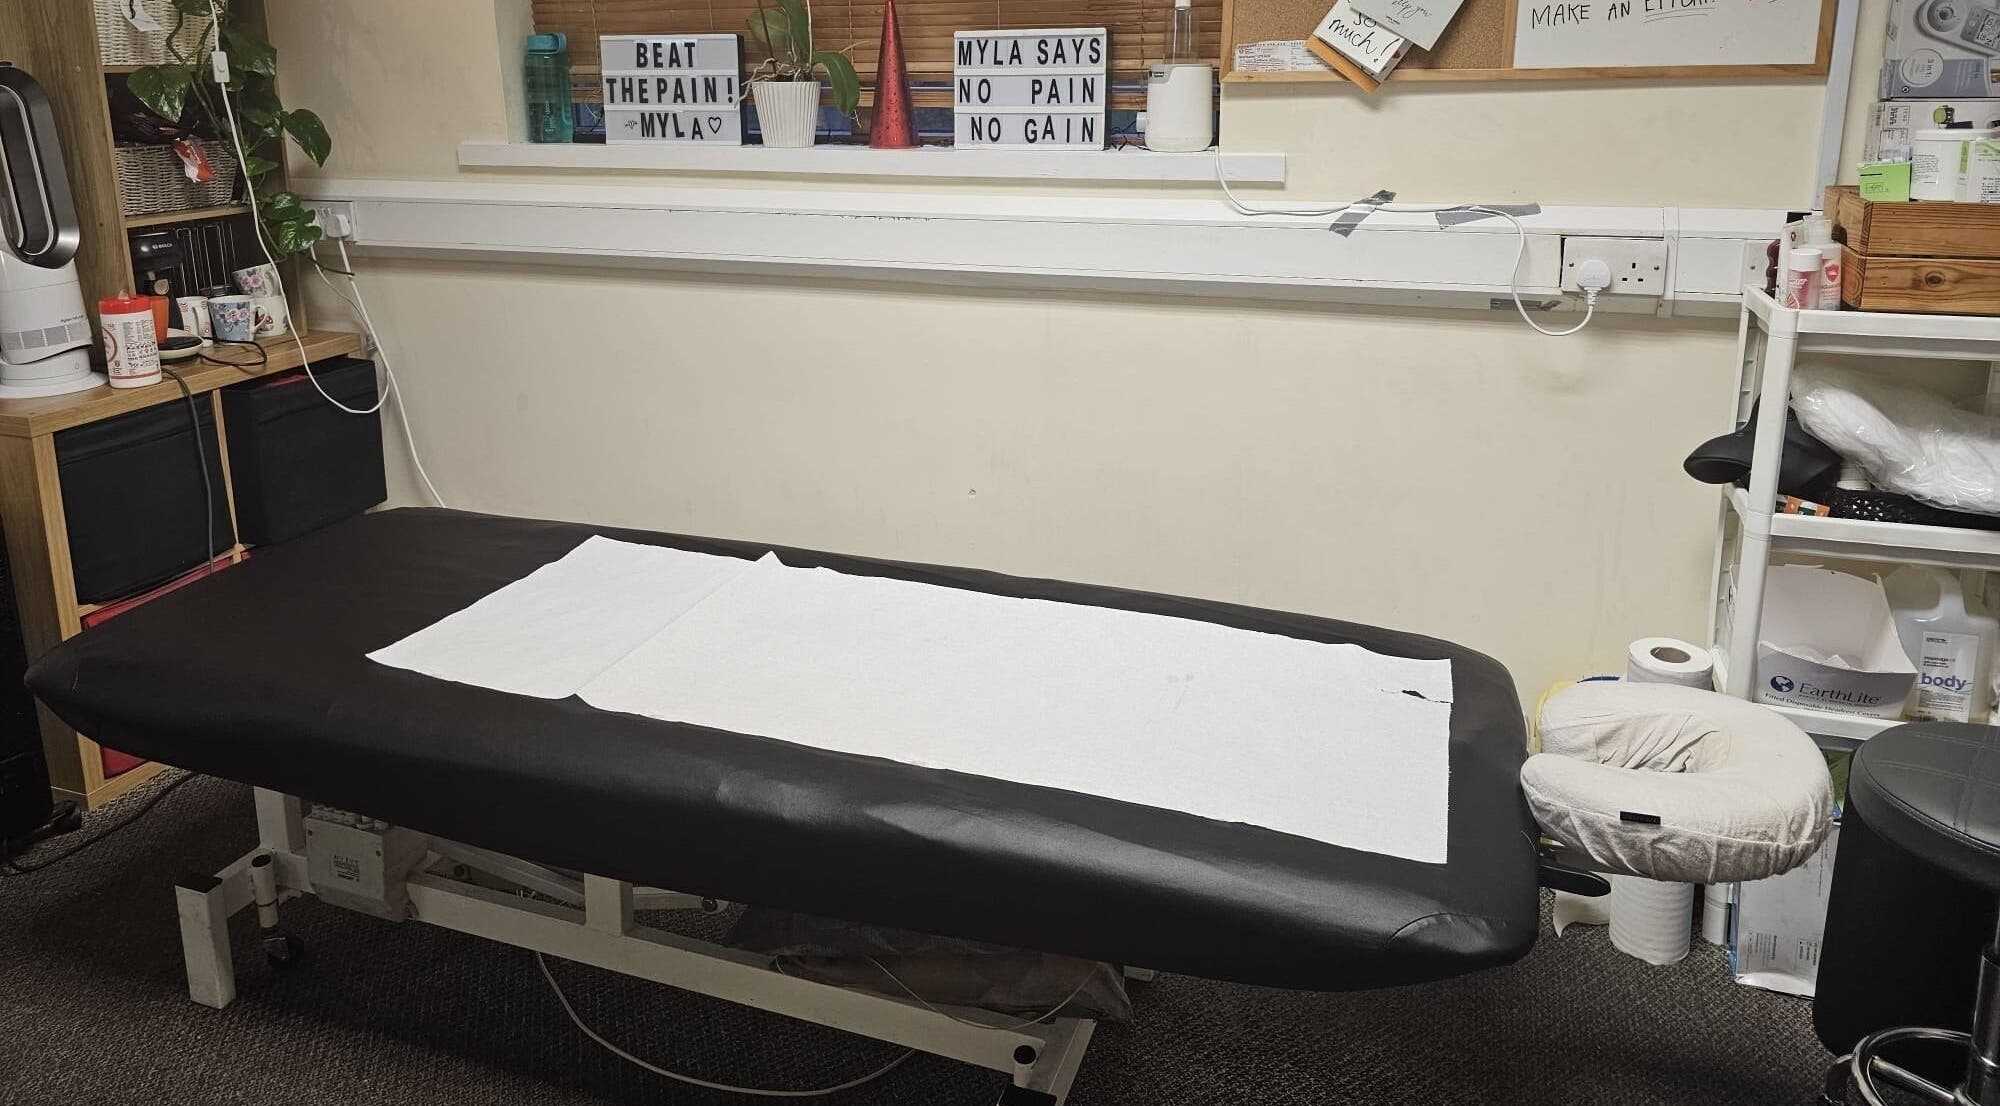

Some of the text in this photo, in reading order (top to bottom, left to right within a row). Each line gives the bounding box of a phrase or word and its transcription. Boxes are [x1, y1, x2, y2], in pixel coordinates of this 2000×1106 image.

[1532, 4, 1591, 29] MAKE
[1608, 4, 1631, 21] AN
[636, 42, 696, 68] BEAT
[958, 37, 1101, 65] MYLA SAYS
[959, 77, 1095, 104] NO PAIN
[640, 112, 704, 140] MYLA
[971, 115, 1094, 143] NO GAIN
[1799, 682, 1880, 705] EarthLite
[1921, 672, 1967, 691] body
